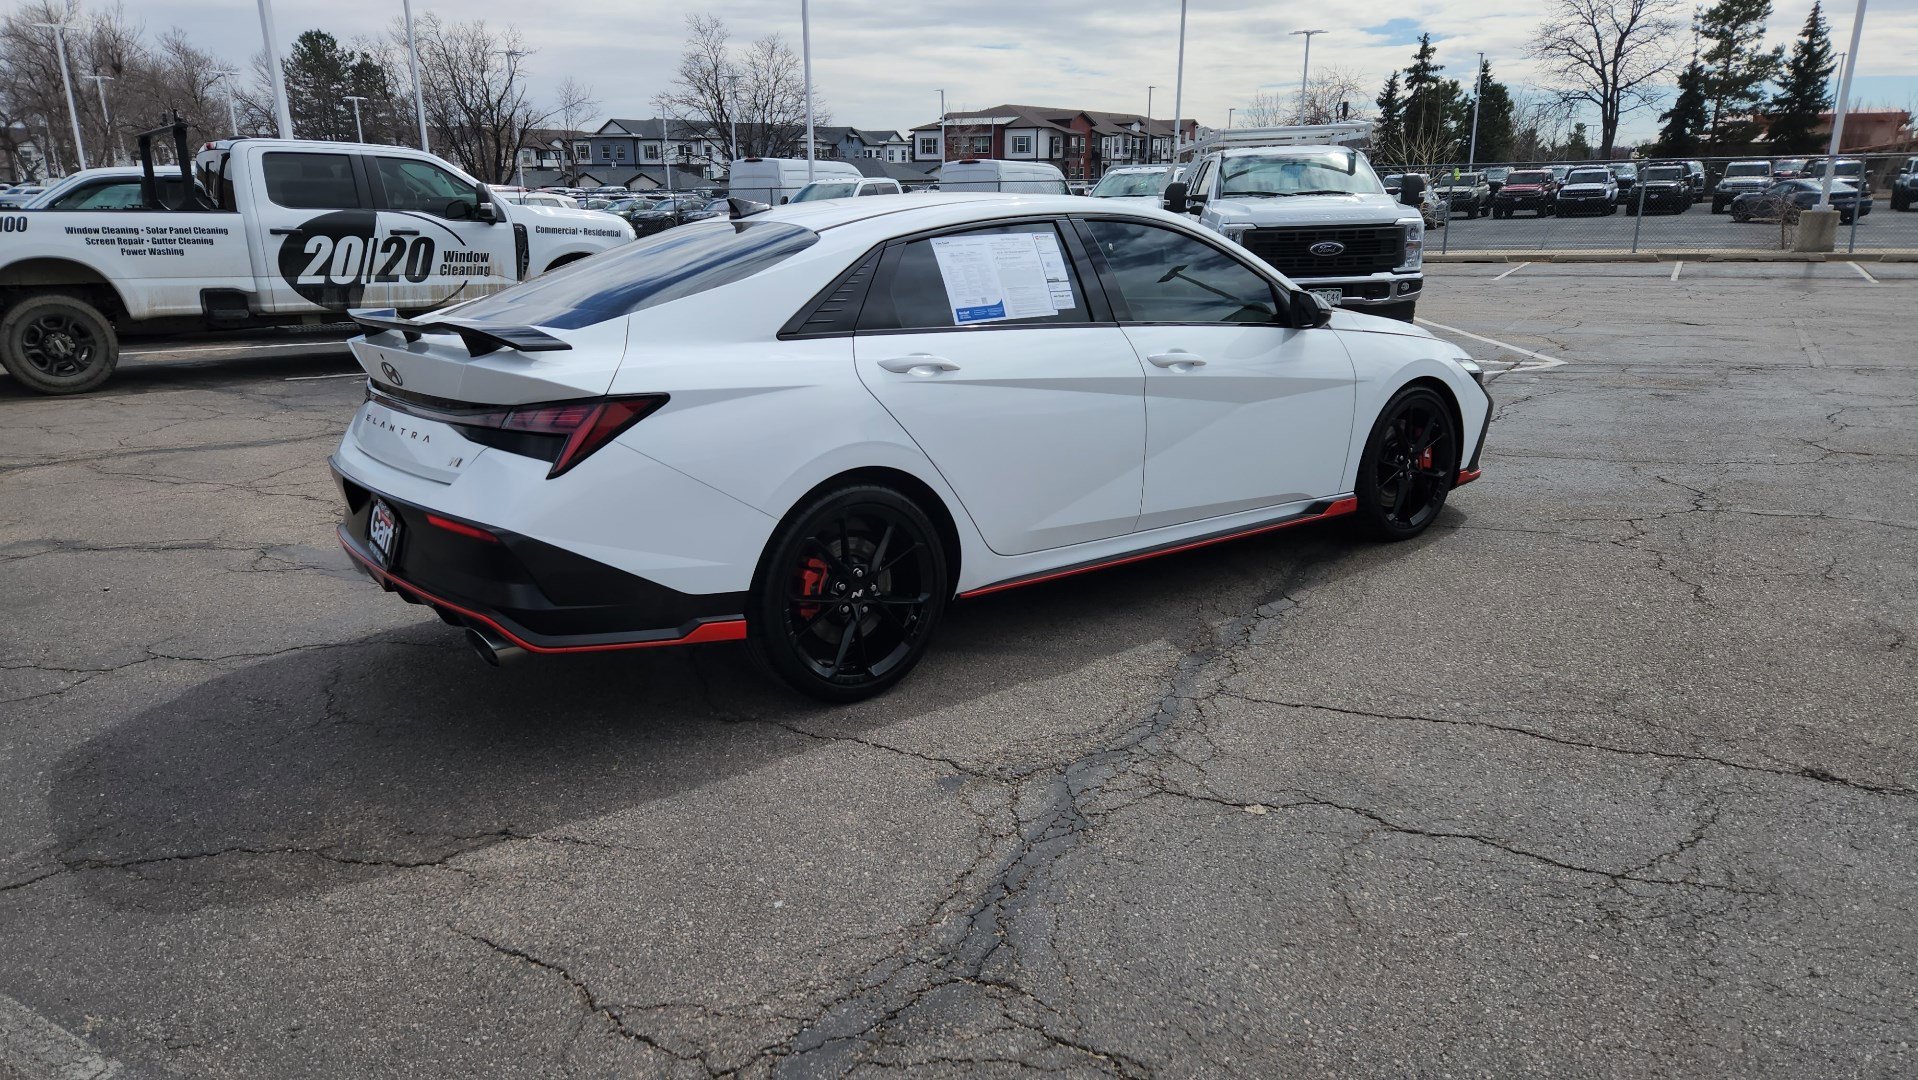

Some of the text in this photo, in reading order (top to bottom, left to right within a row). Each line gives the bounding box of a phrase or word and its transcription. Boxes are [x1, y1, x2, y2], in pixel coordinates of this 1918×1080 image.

[65, 226, 229, 236] Window Cleaning Solar Panel Cleaning
[535, 225, 622, 238] Commercial Residential
[85, 237, 214, 246] Screen Repair Gutter Cleaning
[121, 248, 185, 257] Power Washing
[443, 250, 490, 263] Window
[439, 263, 491, 277] Cleaning
[366, 414, 430, 443] ELANTRA
